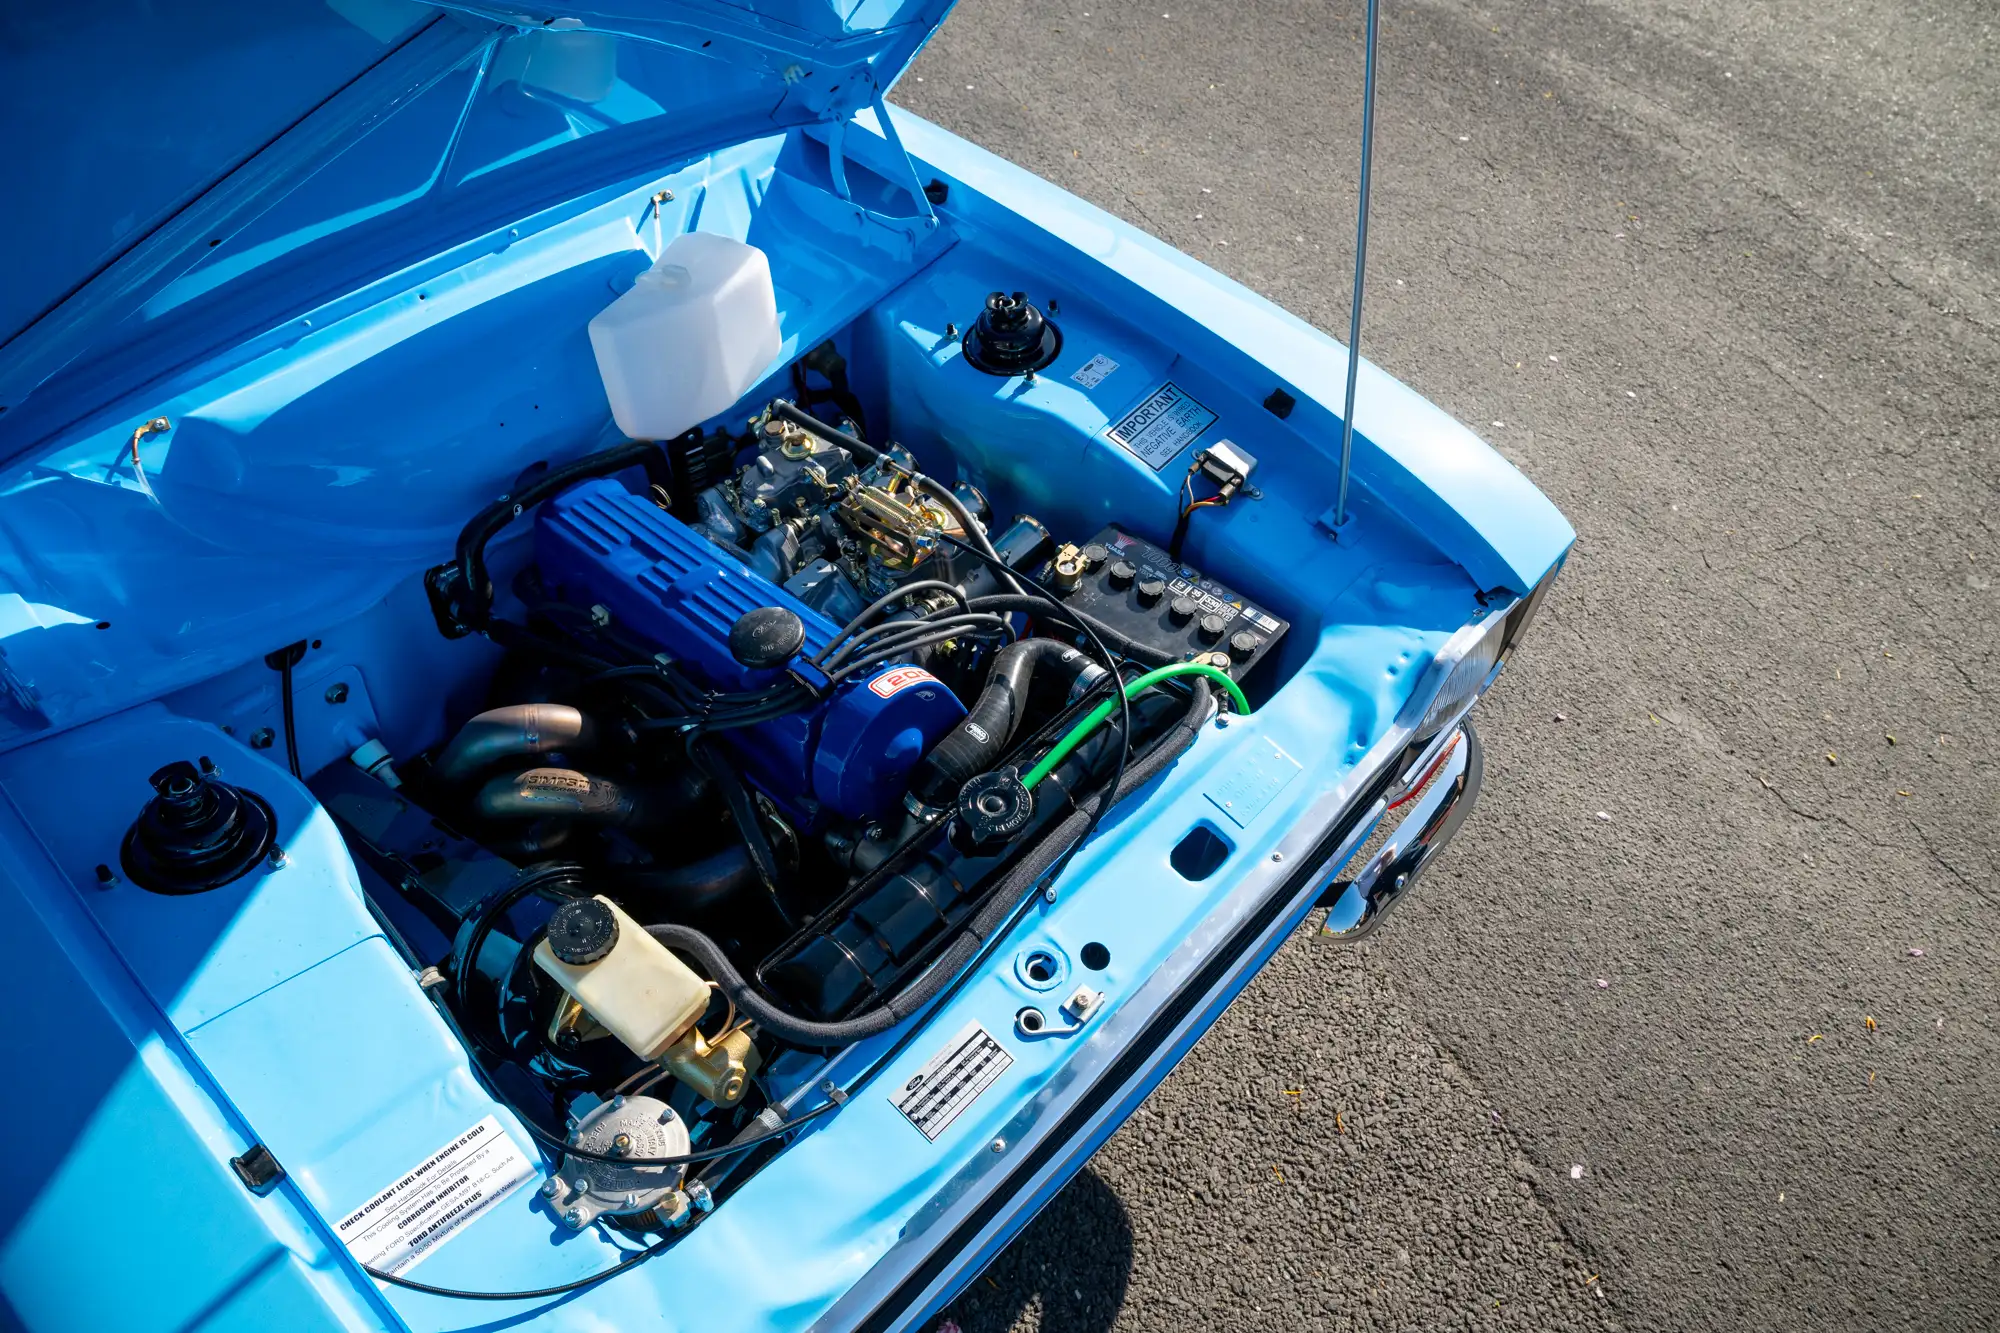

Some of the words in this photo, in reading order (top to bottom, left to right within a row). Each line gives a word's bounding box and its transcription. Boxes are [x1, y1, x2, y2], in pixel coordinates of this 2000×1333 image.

[1115, 387, 1179, 441] IMPORTANT
[1134, 437, 1148, 449] THIS
[1147, 420, 1169, 439] VEHICLE
[1140, 426, 1177, 458] NEGATIVE
[1175, 406, 1201, 428] EARTH
[1160, 446, 1173, 458] SEE
[1173, 421, 1204, 447] HANDBOOK
[1105, 542, 1126, 557] YUASA
[1177, 580, 1185, 588] 12
[1191, 588, 1201, 597] 35
[1204, 596, 1218, 607] 330
[528, 775, 600, 789] SIMPSON
[340, 1211, 365, 1231] CHECK
[364, 1188, 397, 1214] COOLANT
[396, 1175, 416, 1191] LEVEL
[415, 1160, 437, 1177] WHEN
[436, 1143, 460, 1163] ENGINE
[459, 1138, 468, 1146] IS
[467, 1125, 485, 1141] COLD
[363, 1230, 377, 1242] This
[376, 1214, 400, 1233] Cooling
[399, 1198, 422, 1217] System
[422, 1189, 433, 1200] Has
[434, 1183, 442, 1191] To
[441, 1177, 450, 1186] Be
[450, 1158, 477, 1179] Protected
[477, 1152, 485, 1161] By
[385, 1202, 398, 1213] See
[398, 1181, 426, 1204] Handbook
[427, 1173, 438, 1183] For
[437, 1160, 457, 1176] Details
[385, 1236, 404, 1251] FORD
[405, 1209, 441, 1238] Specification
[492, 1161, 506, 1174] Such
[398, 1199, 437, 1230] CORROSION
[436, 1175, 470, 1202] INHIBITOR
[415, 1241, 433, 1256] 50/50
[432, 1225, 455, 1243] Mixture
[460, 1199, 490, 1222] Antifreeze
[489, 1191, 501, 1202] and
[500, 1178, 518, 1193] Water
[427, 1203, 466, 1234] ANTIFREEZE
